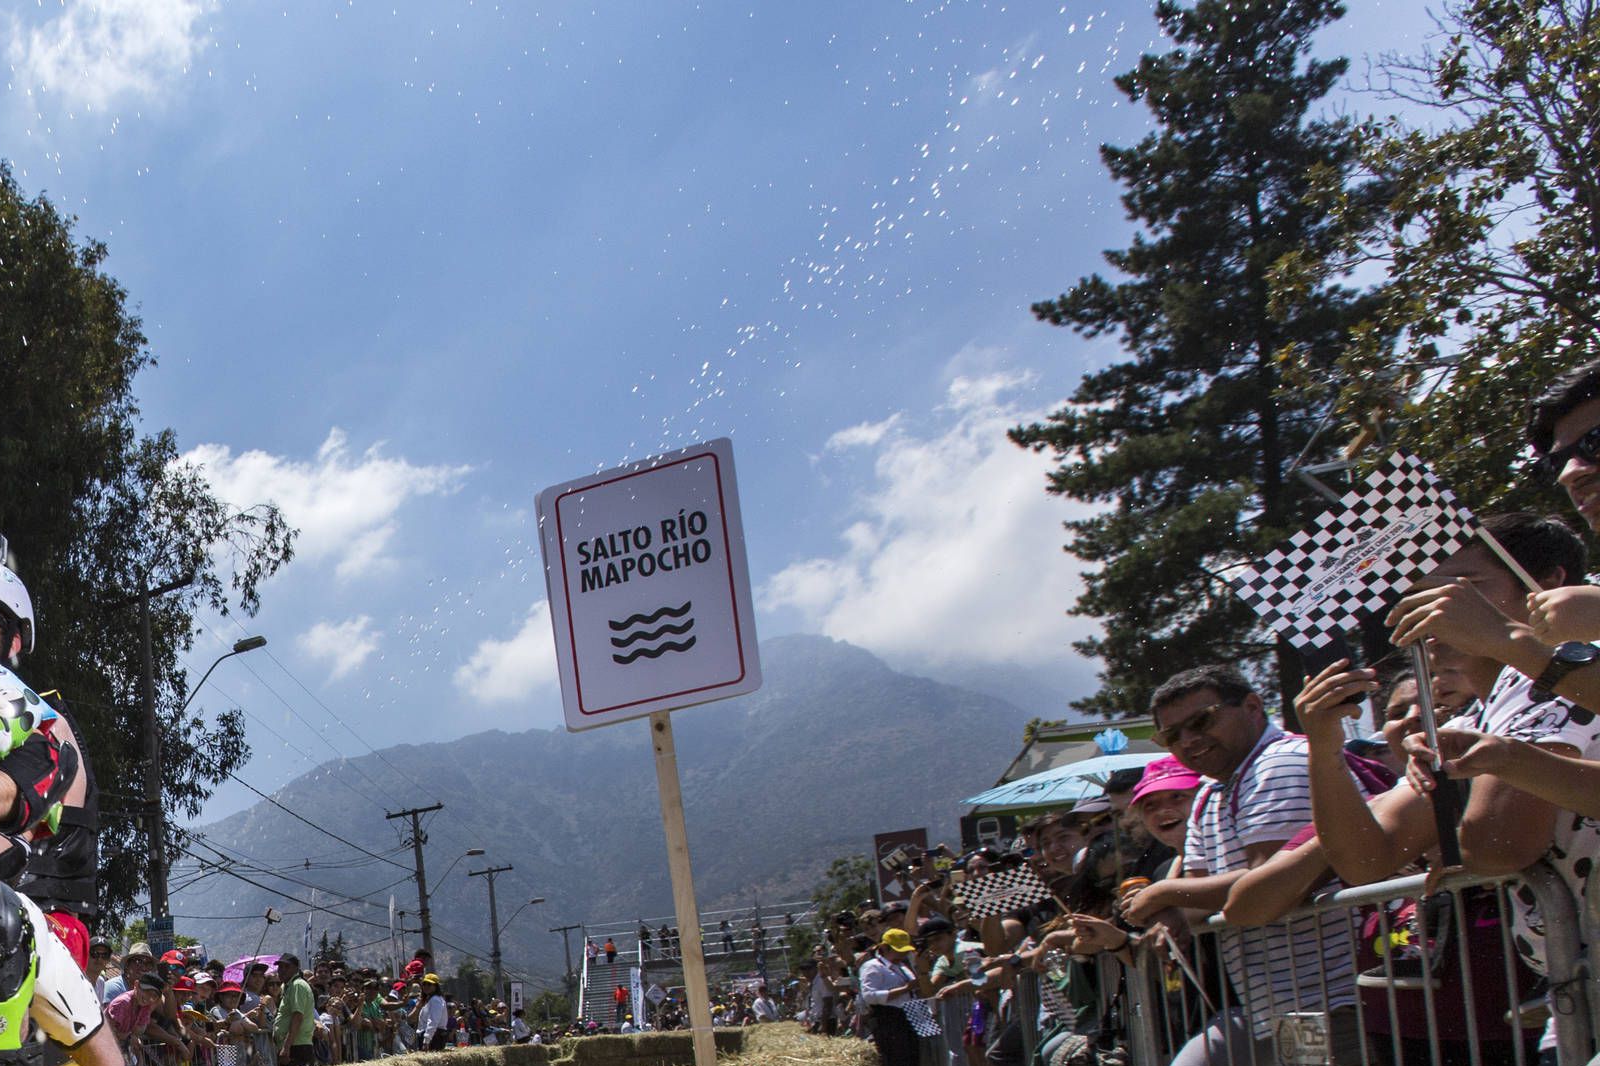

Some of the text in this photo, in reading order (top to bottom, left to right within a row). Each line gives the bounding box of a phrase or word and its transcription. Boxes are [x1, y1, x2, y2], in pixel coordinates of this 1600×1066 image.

[577, 508, 708, 565] SALTO RÍO
[581, 538, 711, 593] MAPOCHO
